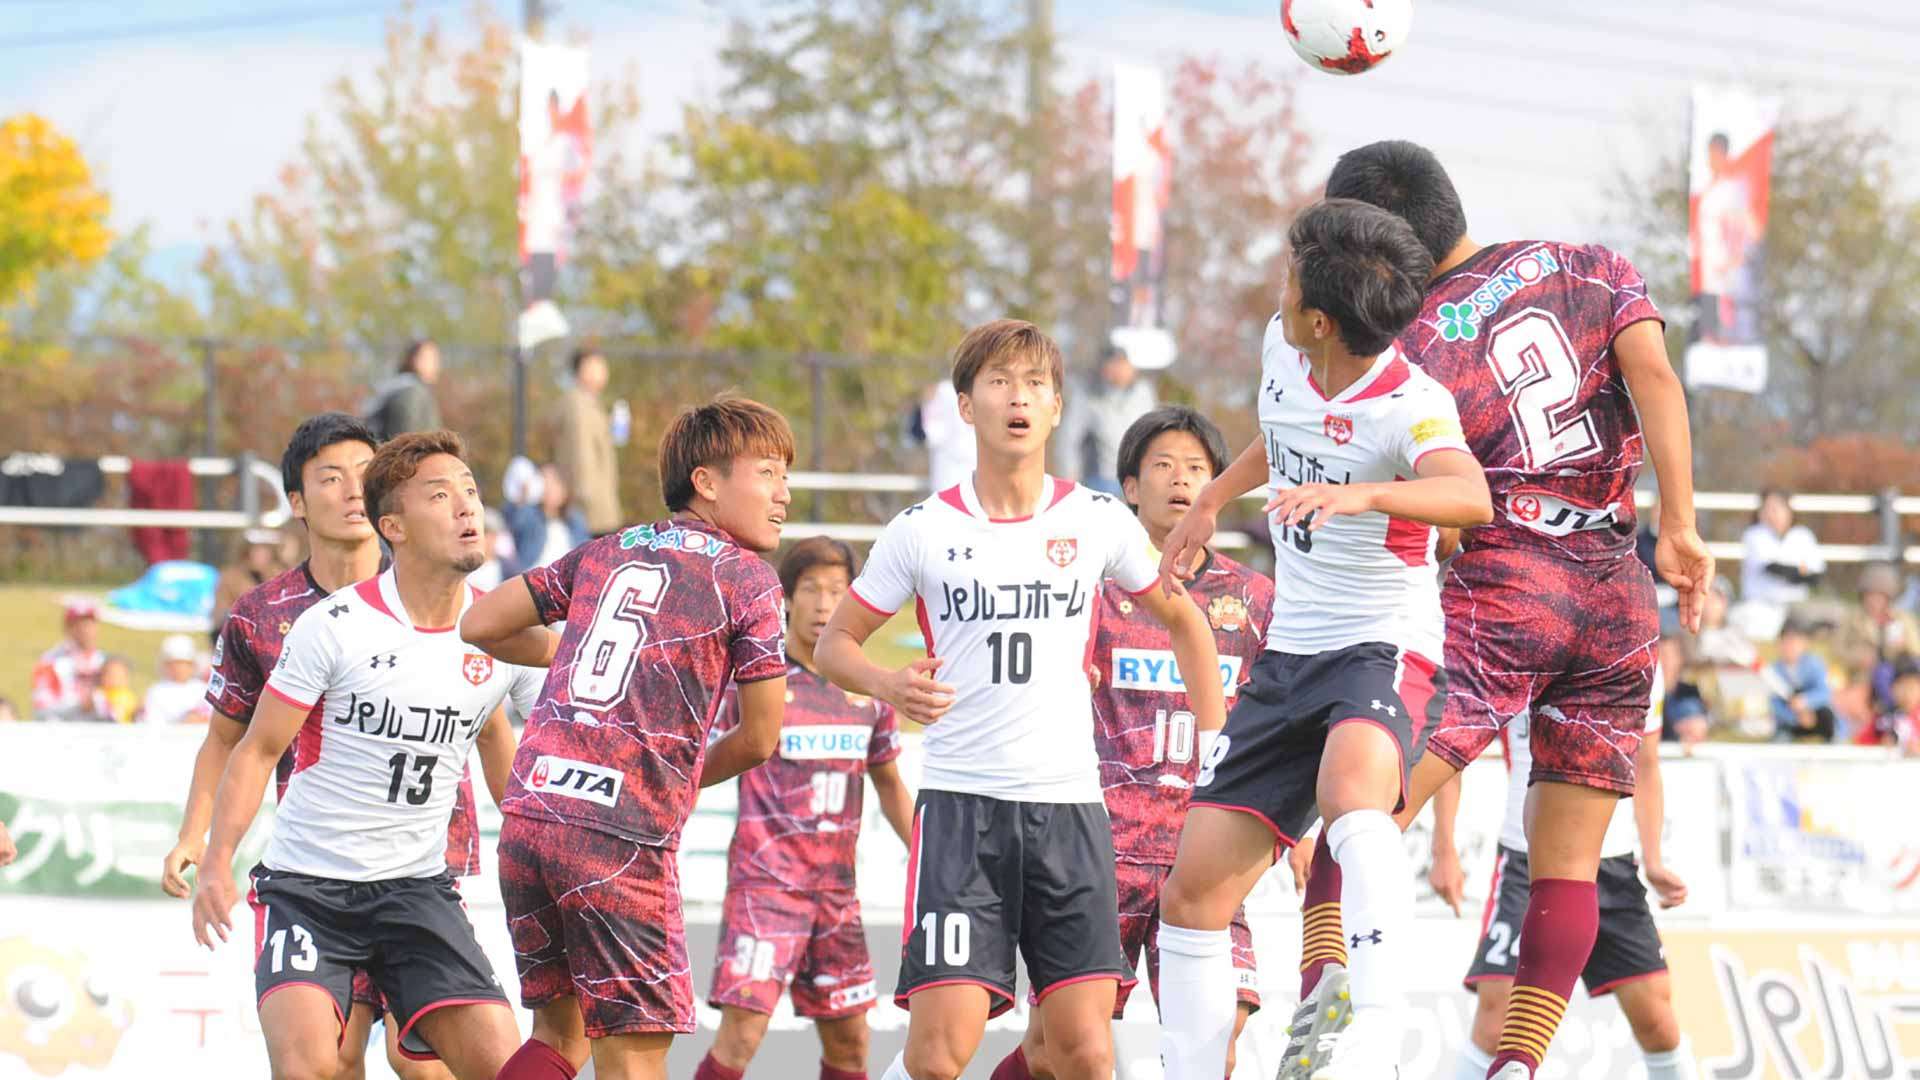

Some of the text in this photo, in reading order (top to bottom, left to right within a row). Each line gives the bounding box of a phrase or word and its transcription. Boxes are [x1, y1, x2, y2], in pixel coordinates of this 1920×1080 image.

[1474, 249, 1559, 316] SENON
[1485, 306, 1603, 474] 2
[568, 560, 671, 712] 6
[986, 631, 1032, 685] 10
[1118, 656, 1233, 688] RYUO
[1152, 708, 1195, 764] 10
[386, 752, 439, 806] 13
[550, 768, 616, 798] JTA
[809, 771, 848, 815] 30
[269, 924, 319, 974] 13
[730, 934, 776, 982] 30
[921, 911, 971, 967] 10
[1485, 921, 1521, 966] 2
